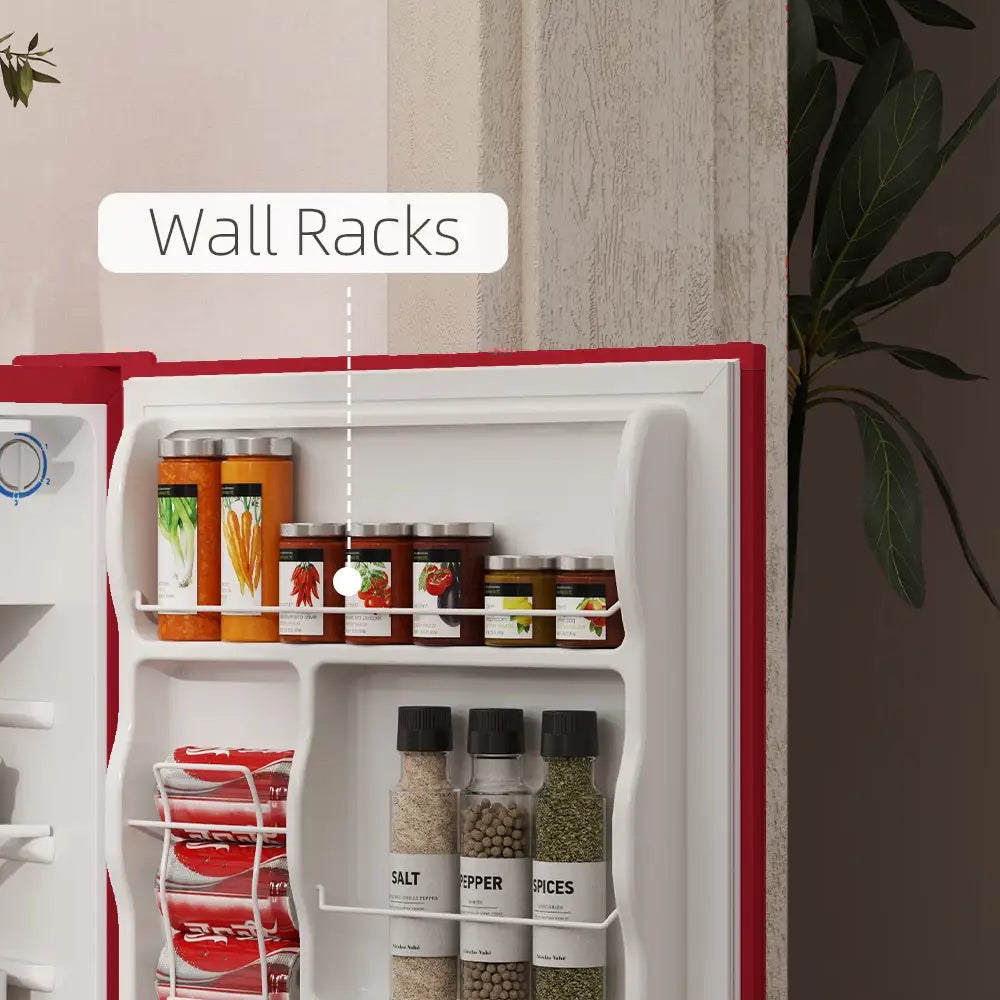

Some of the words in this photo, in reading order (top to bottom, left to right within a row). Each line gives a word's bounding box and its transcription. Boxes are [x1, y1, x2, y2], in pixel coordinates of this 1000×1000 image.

[391, 870, 421, 886] SALT
[460, 874, 503, 890] PEPPER
[533, 879, 574, 895] SPICES
